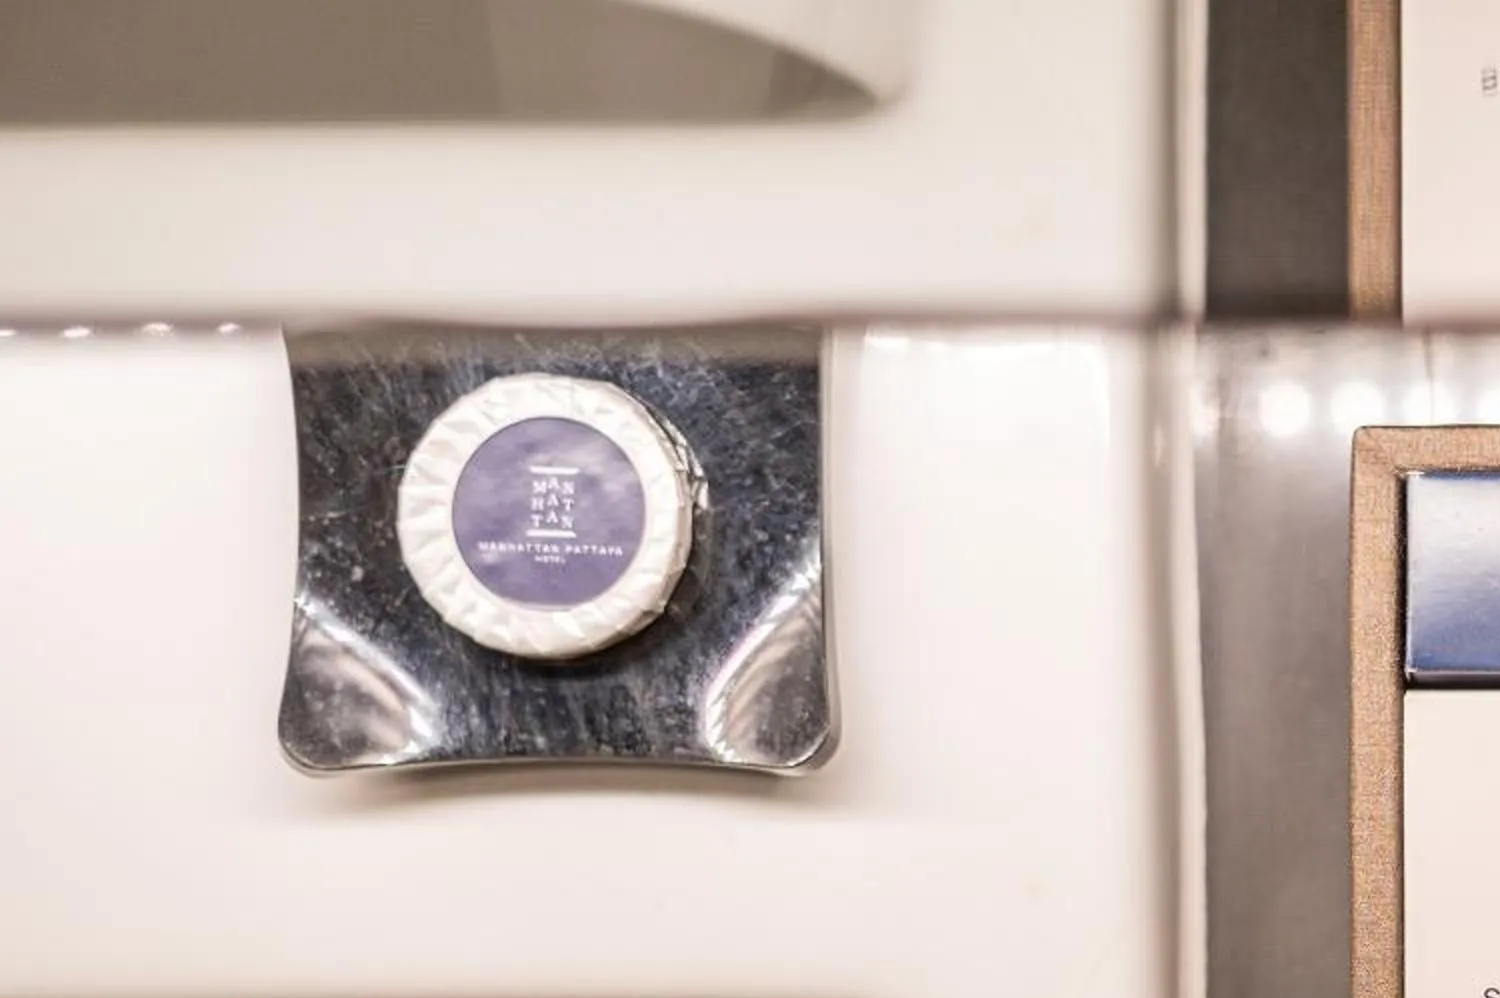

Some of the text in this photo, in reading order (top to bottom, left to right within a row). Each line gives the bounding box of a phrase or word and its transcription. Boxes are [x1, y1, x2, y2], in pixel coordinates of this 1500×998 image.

[532, 477, 575, 494] MAN
[530, 494, 575, 511] HAT
[530, 511, 574, 529] TAN
[565, 543, 623, 557] PATTAYA
